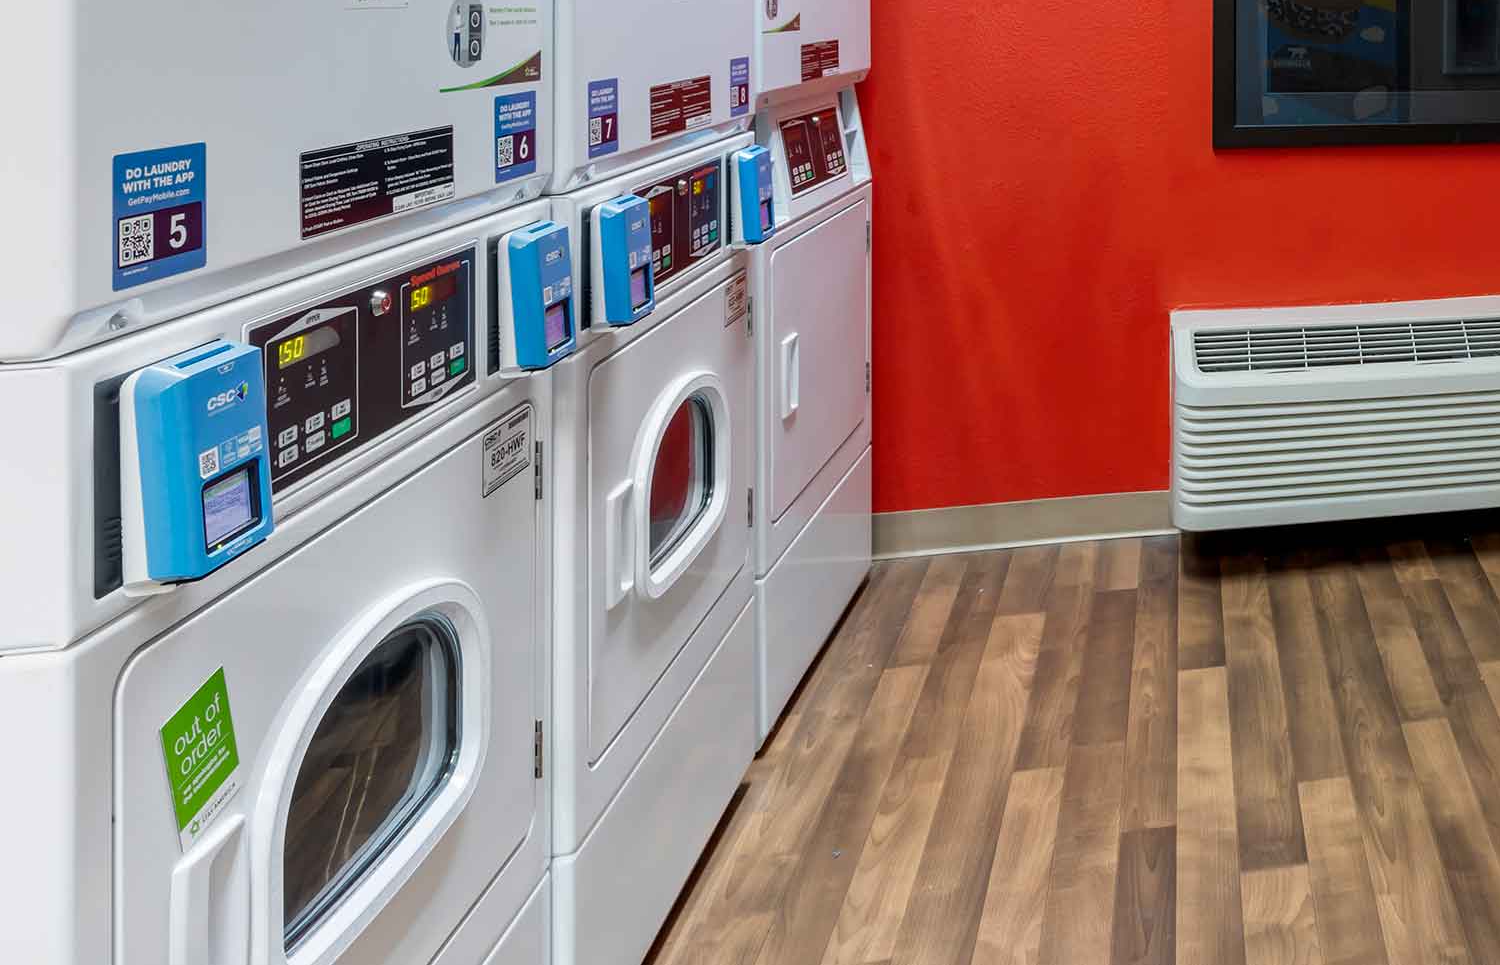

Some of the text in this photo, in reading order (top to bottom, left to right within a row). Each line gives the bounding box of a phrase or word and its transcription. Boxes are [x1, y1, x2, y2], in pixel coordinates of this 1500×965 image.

[605, 118, 613, 139] 7
[519, 135, 529, 159] 6
[126, 159, 192, 180] DO LAUNDRY
[123, 171, 195, 194] WITH THE APP
[128, 188, 190, 206] GetPayMobile.com
[169, 213, 187, 249] 5
[306, 313, 321, 325] UPPER
[207, 389, 236, 411] CSC
[174, 715, 202, 755] out
[205, 691, 221, 722] of
[181, 720, 222, 775] order
